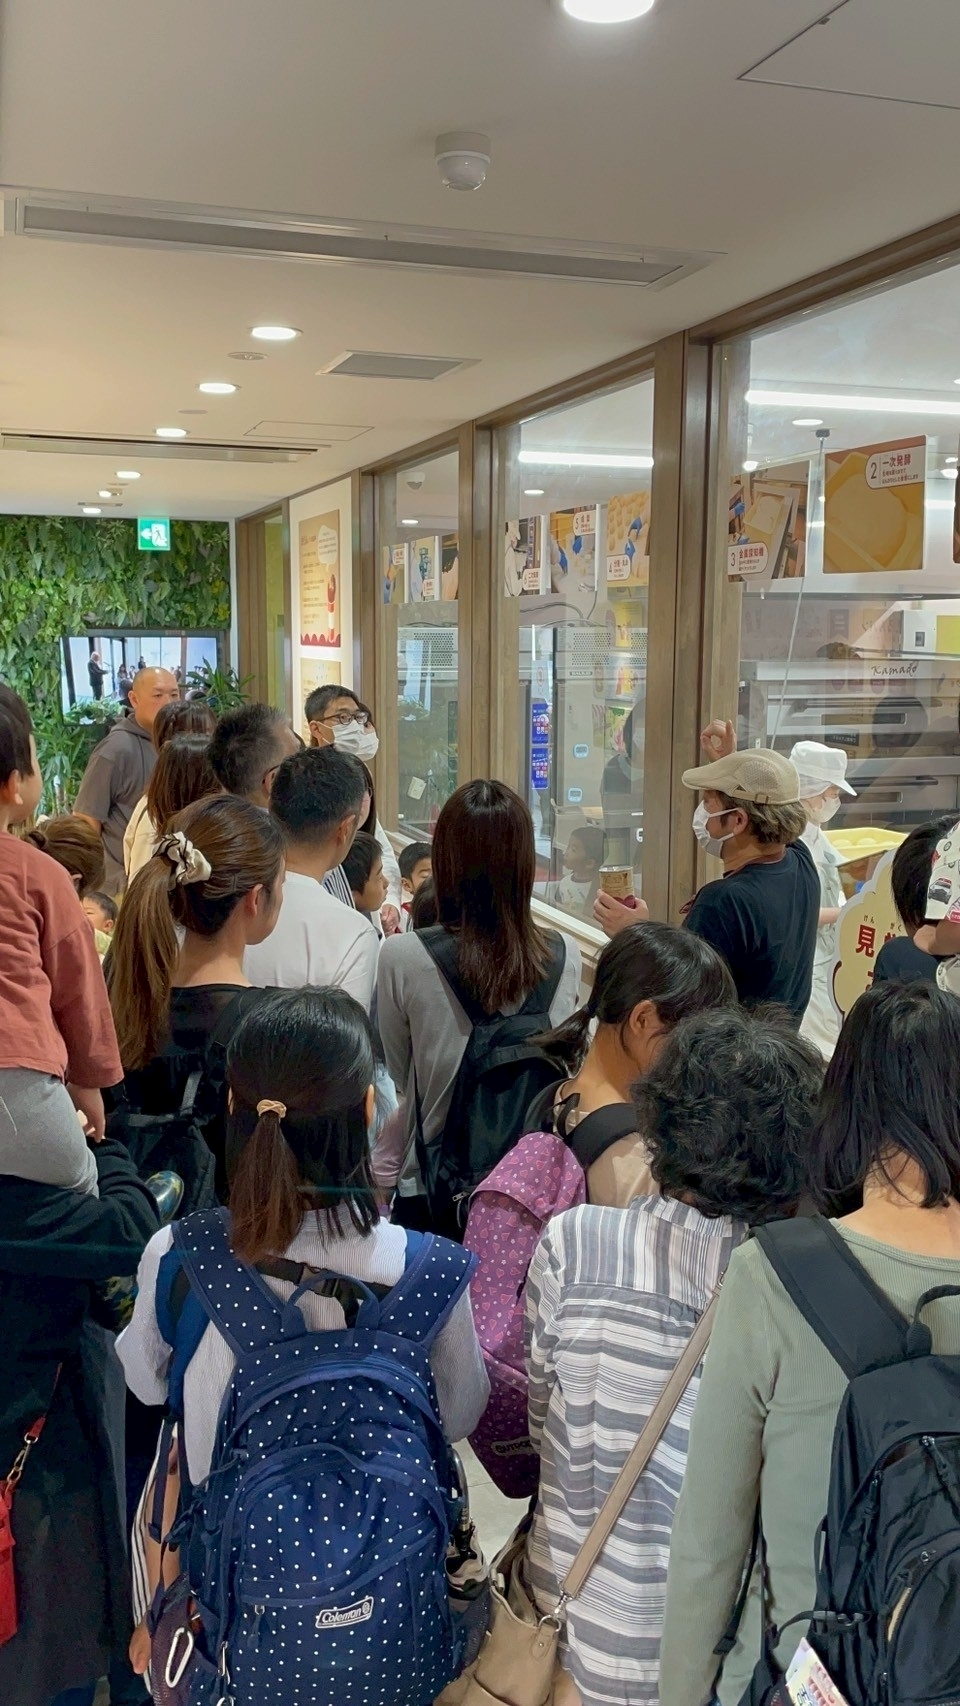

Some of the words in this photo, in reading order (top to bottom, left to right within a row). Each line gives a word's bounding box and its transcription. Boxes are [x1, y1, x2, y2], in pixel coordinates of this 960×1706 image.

[870, 461, 878, 480] 2
[882, 454, 911, 467] 一次発酵
[730, 552, 736, 567] 3
[871, 660, 920, 678] Kamado
[322, 1608, 361, 1623] Coleman
